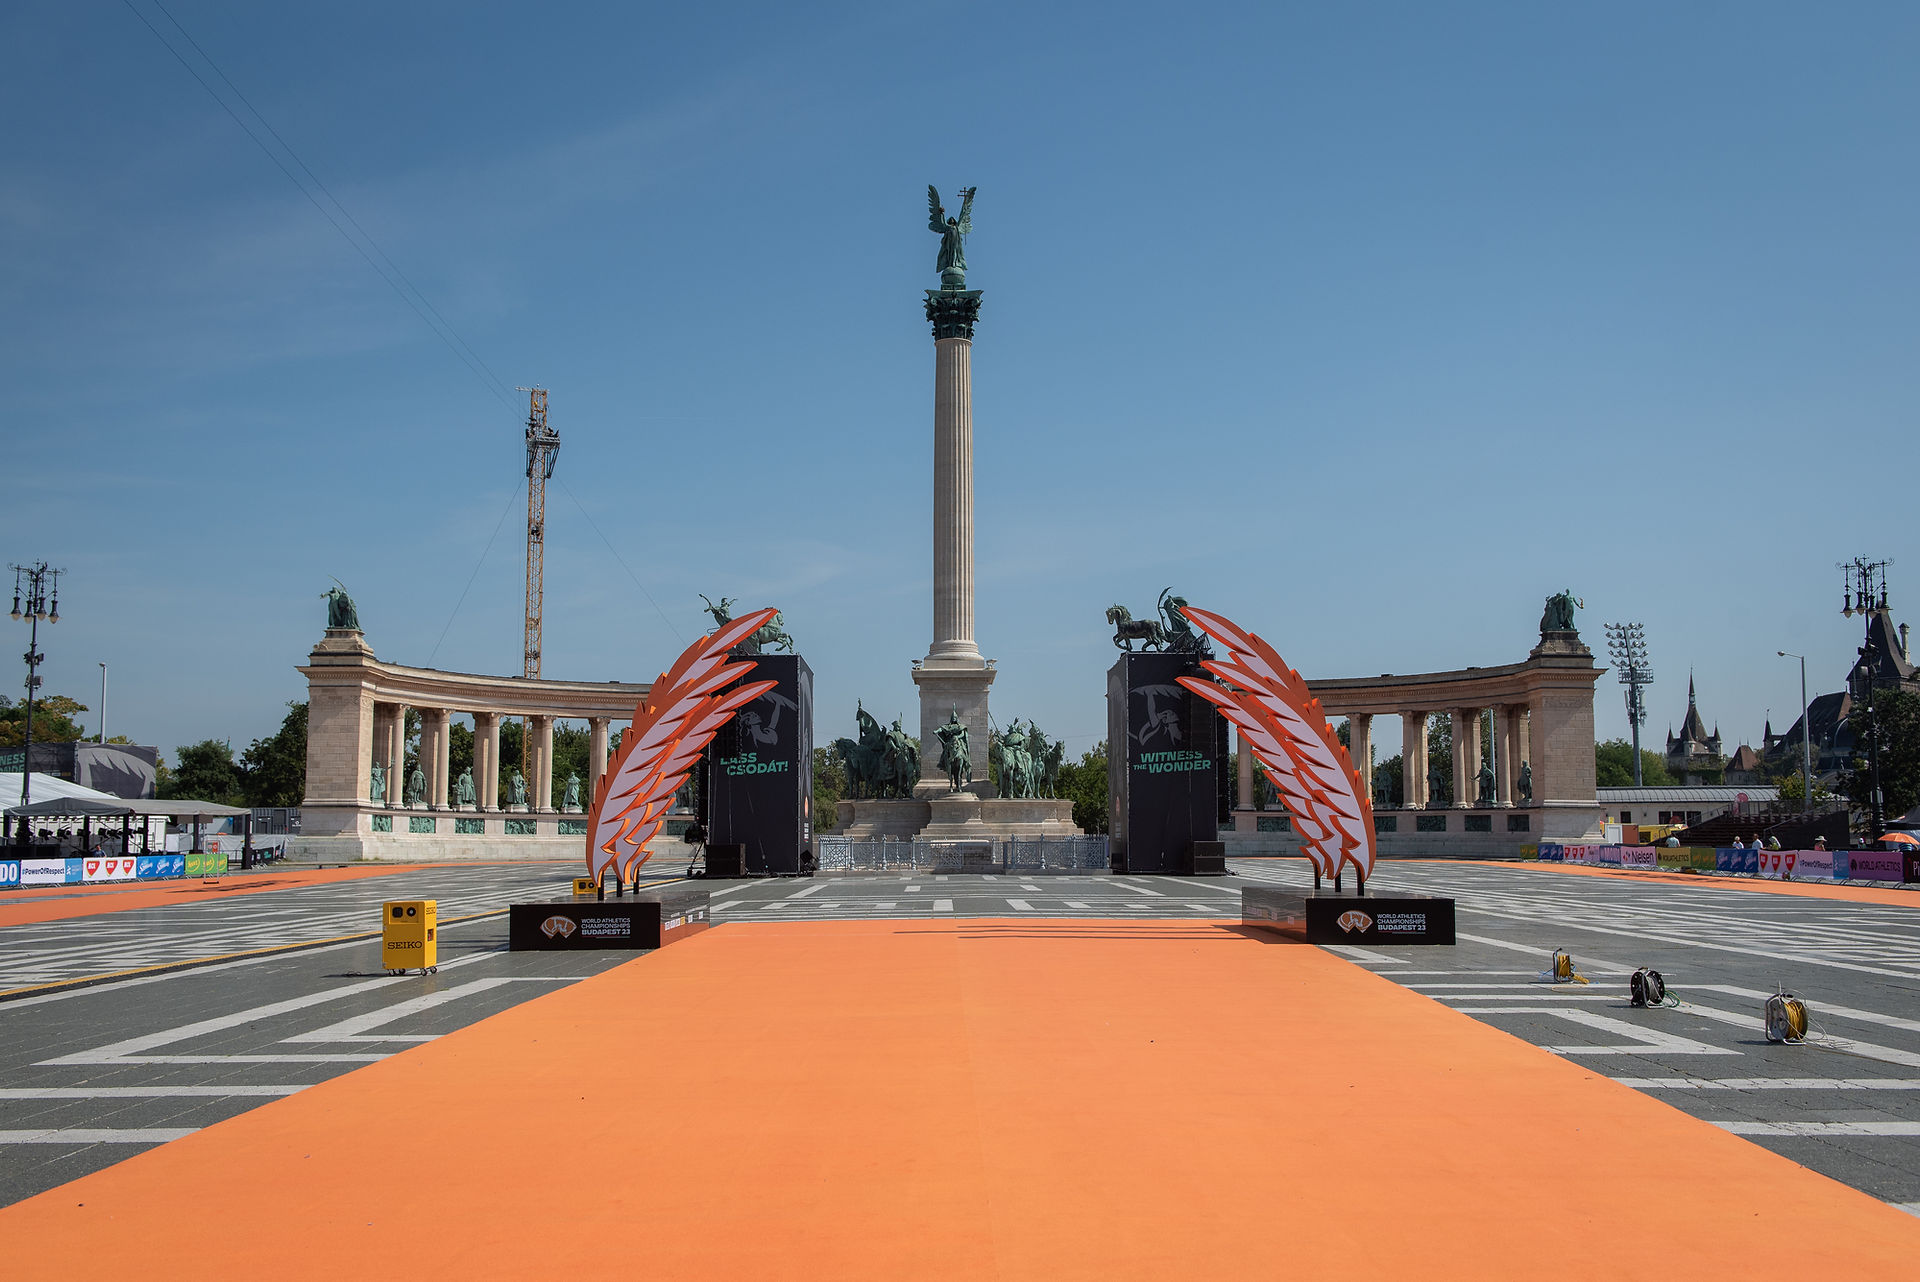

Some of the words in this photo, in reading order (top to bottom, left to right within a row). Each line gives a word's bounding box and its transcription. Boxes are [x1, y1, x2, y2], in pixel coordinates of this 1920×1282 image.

[1140, 750, 1203, 763] WITNESS
[1148, 759, 1211, 773] WONDER
[1632, 850, 1654, 863] Nielsen
[22, 867, 65, 876] #PowerOfRespect
[387, 941, 423, 950] SEIKO
